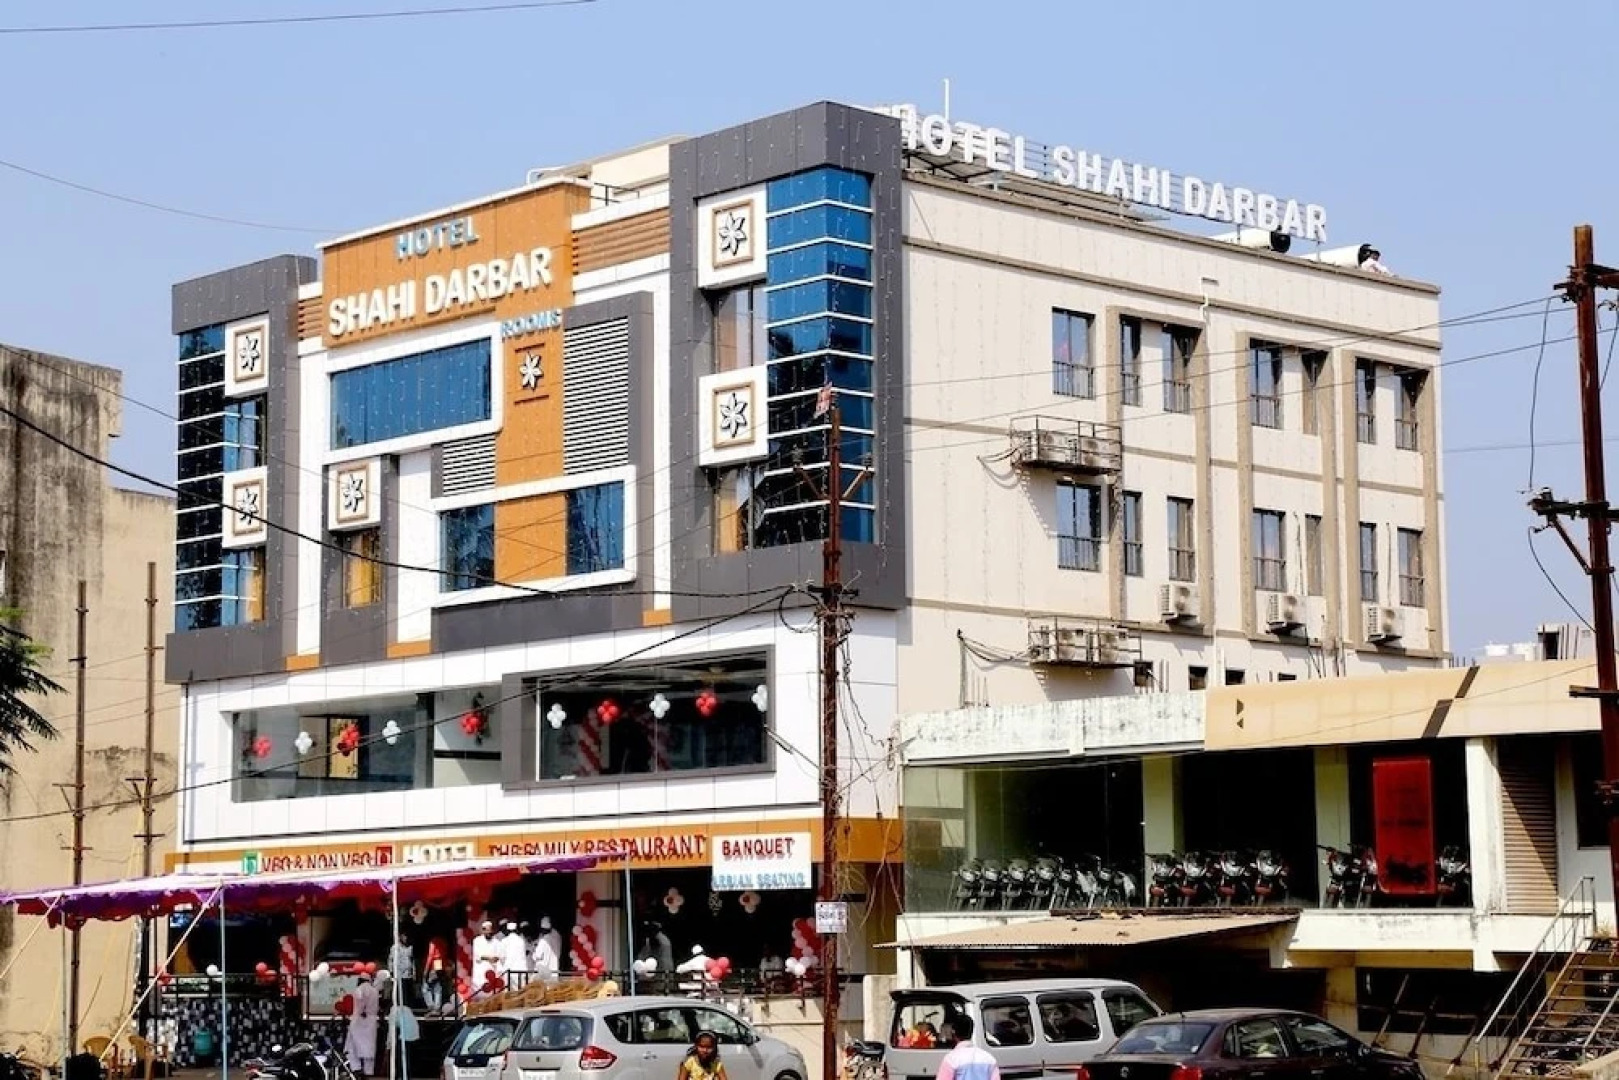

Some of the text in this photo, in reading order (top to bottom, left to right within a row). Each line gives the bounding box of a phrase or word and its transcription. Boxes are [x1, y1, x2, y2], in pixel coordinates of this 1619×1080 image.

[1053, 145, 1170, 208] SHAHI
[1184, 176, 1327, 243] DARBAR
[397, 216, 479, 261] HOTEL
[329, 246, 552, 336] SHAHI DARBAR
[502, 308, 562, 338] ROOMS
[307, 852, 338, 869] NON
[585, 834, 706, 861] RESTAURANT
[722, 837, 795, 857] BANQUET
